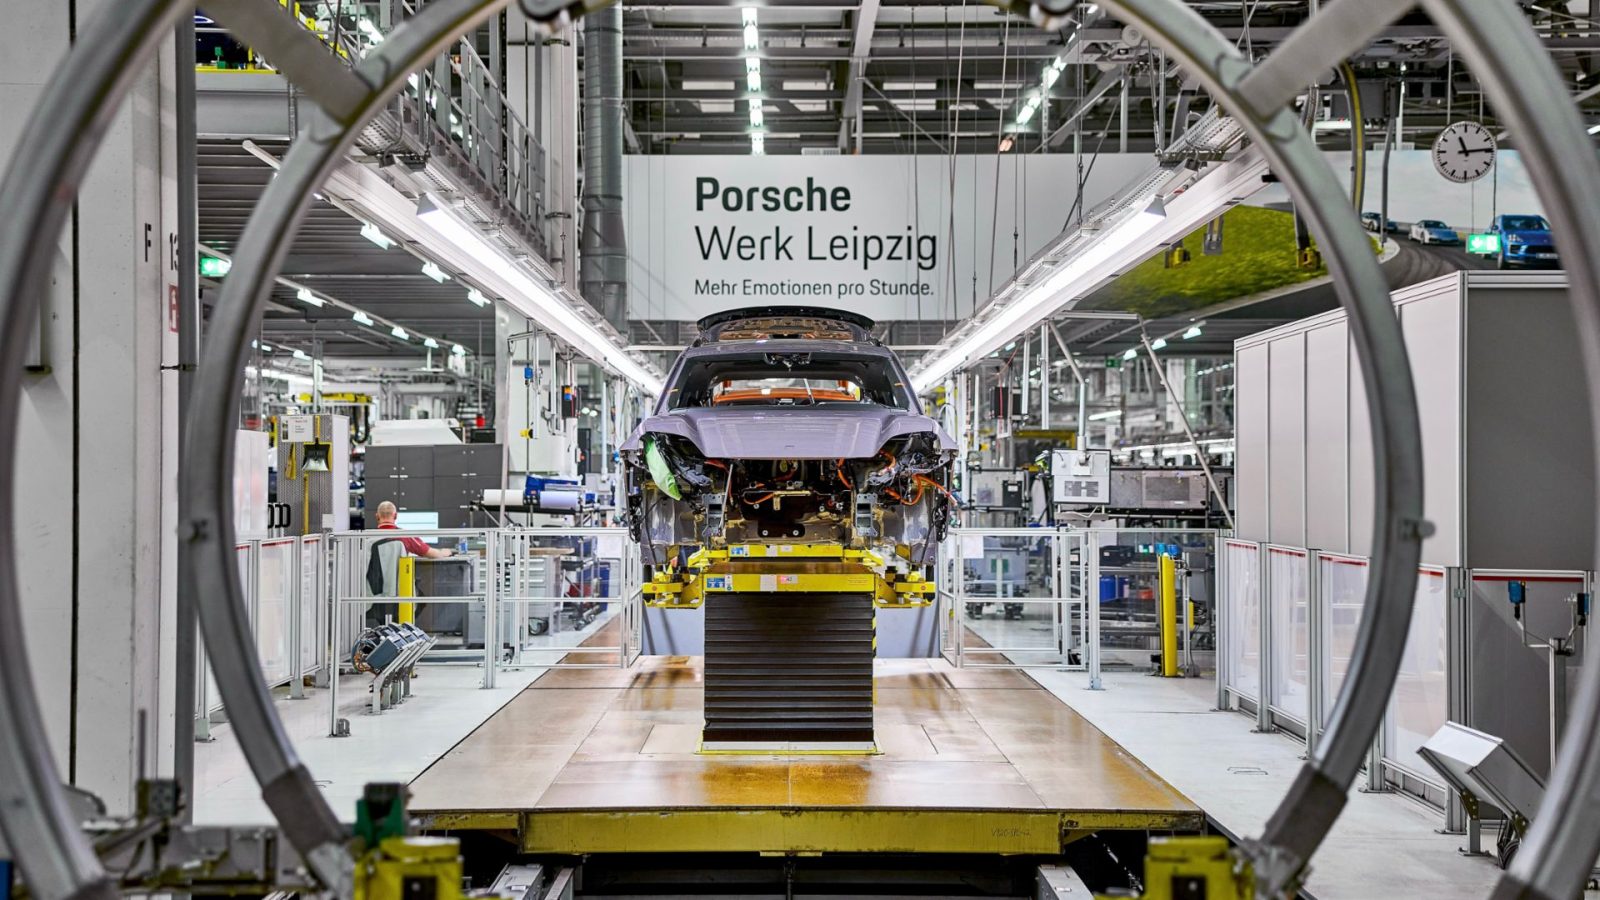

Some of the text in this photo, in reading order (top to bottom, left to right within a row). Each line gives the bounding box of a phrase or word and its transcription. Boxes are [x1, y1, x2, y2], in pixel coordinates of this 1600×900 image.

[696, 177, 851, 212] Porsche
[145, 223, 152, 262] F
[695, 225, 937, 270] Werk Leipzig
[695, 279, 935, 299] Mehr Emotionen pro Stunde.
